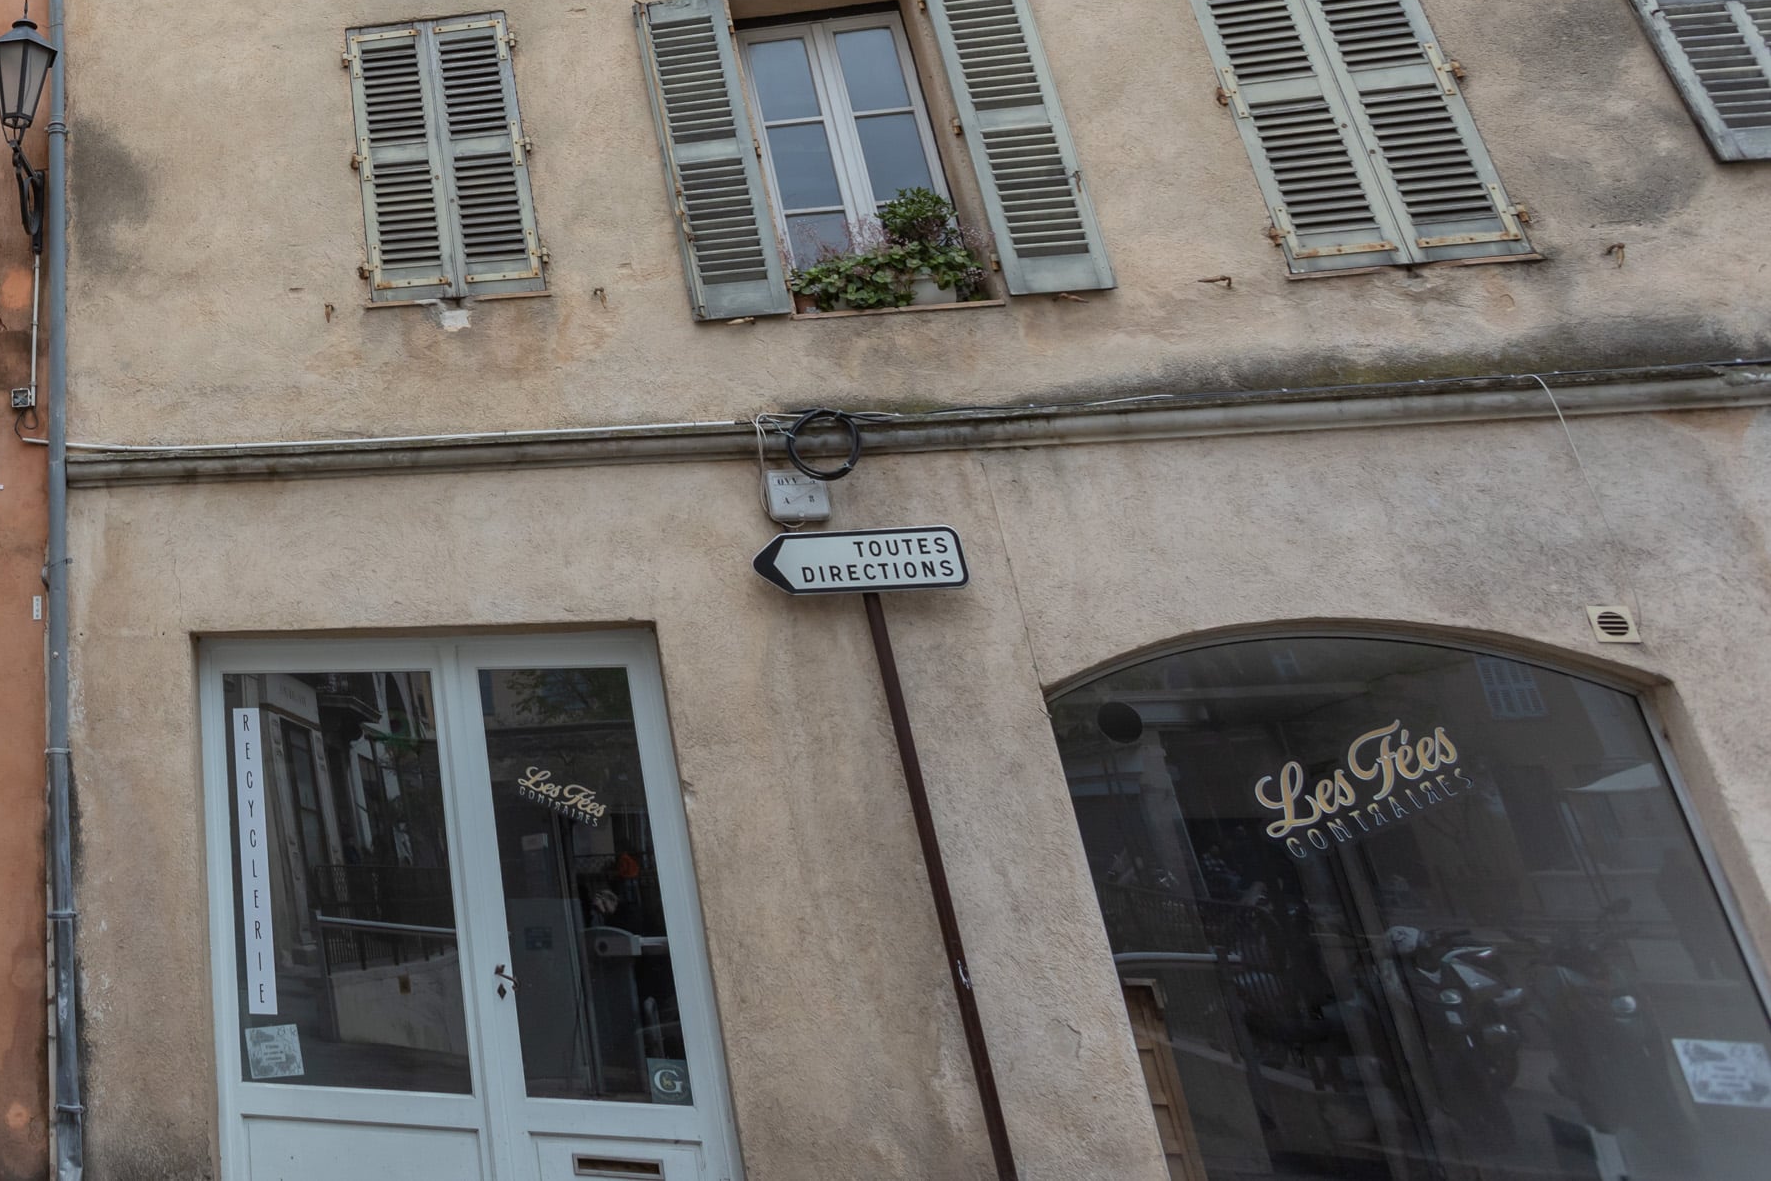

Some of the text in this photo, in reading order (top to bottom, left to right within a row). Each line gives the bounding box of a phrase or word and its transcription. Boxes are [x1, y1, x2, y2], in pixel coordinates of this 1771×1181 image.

[853, 537, 949, 558] TOUTES
[801, 560, 955, 584] DIRECTIONS
[517, 766, 608, 818] Les Fées
[1254, 718, 1458, 839] Les Fées
[242, 714, 265, 1004] RECYCLERIE
[653, 1068, 683, 1093] G
